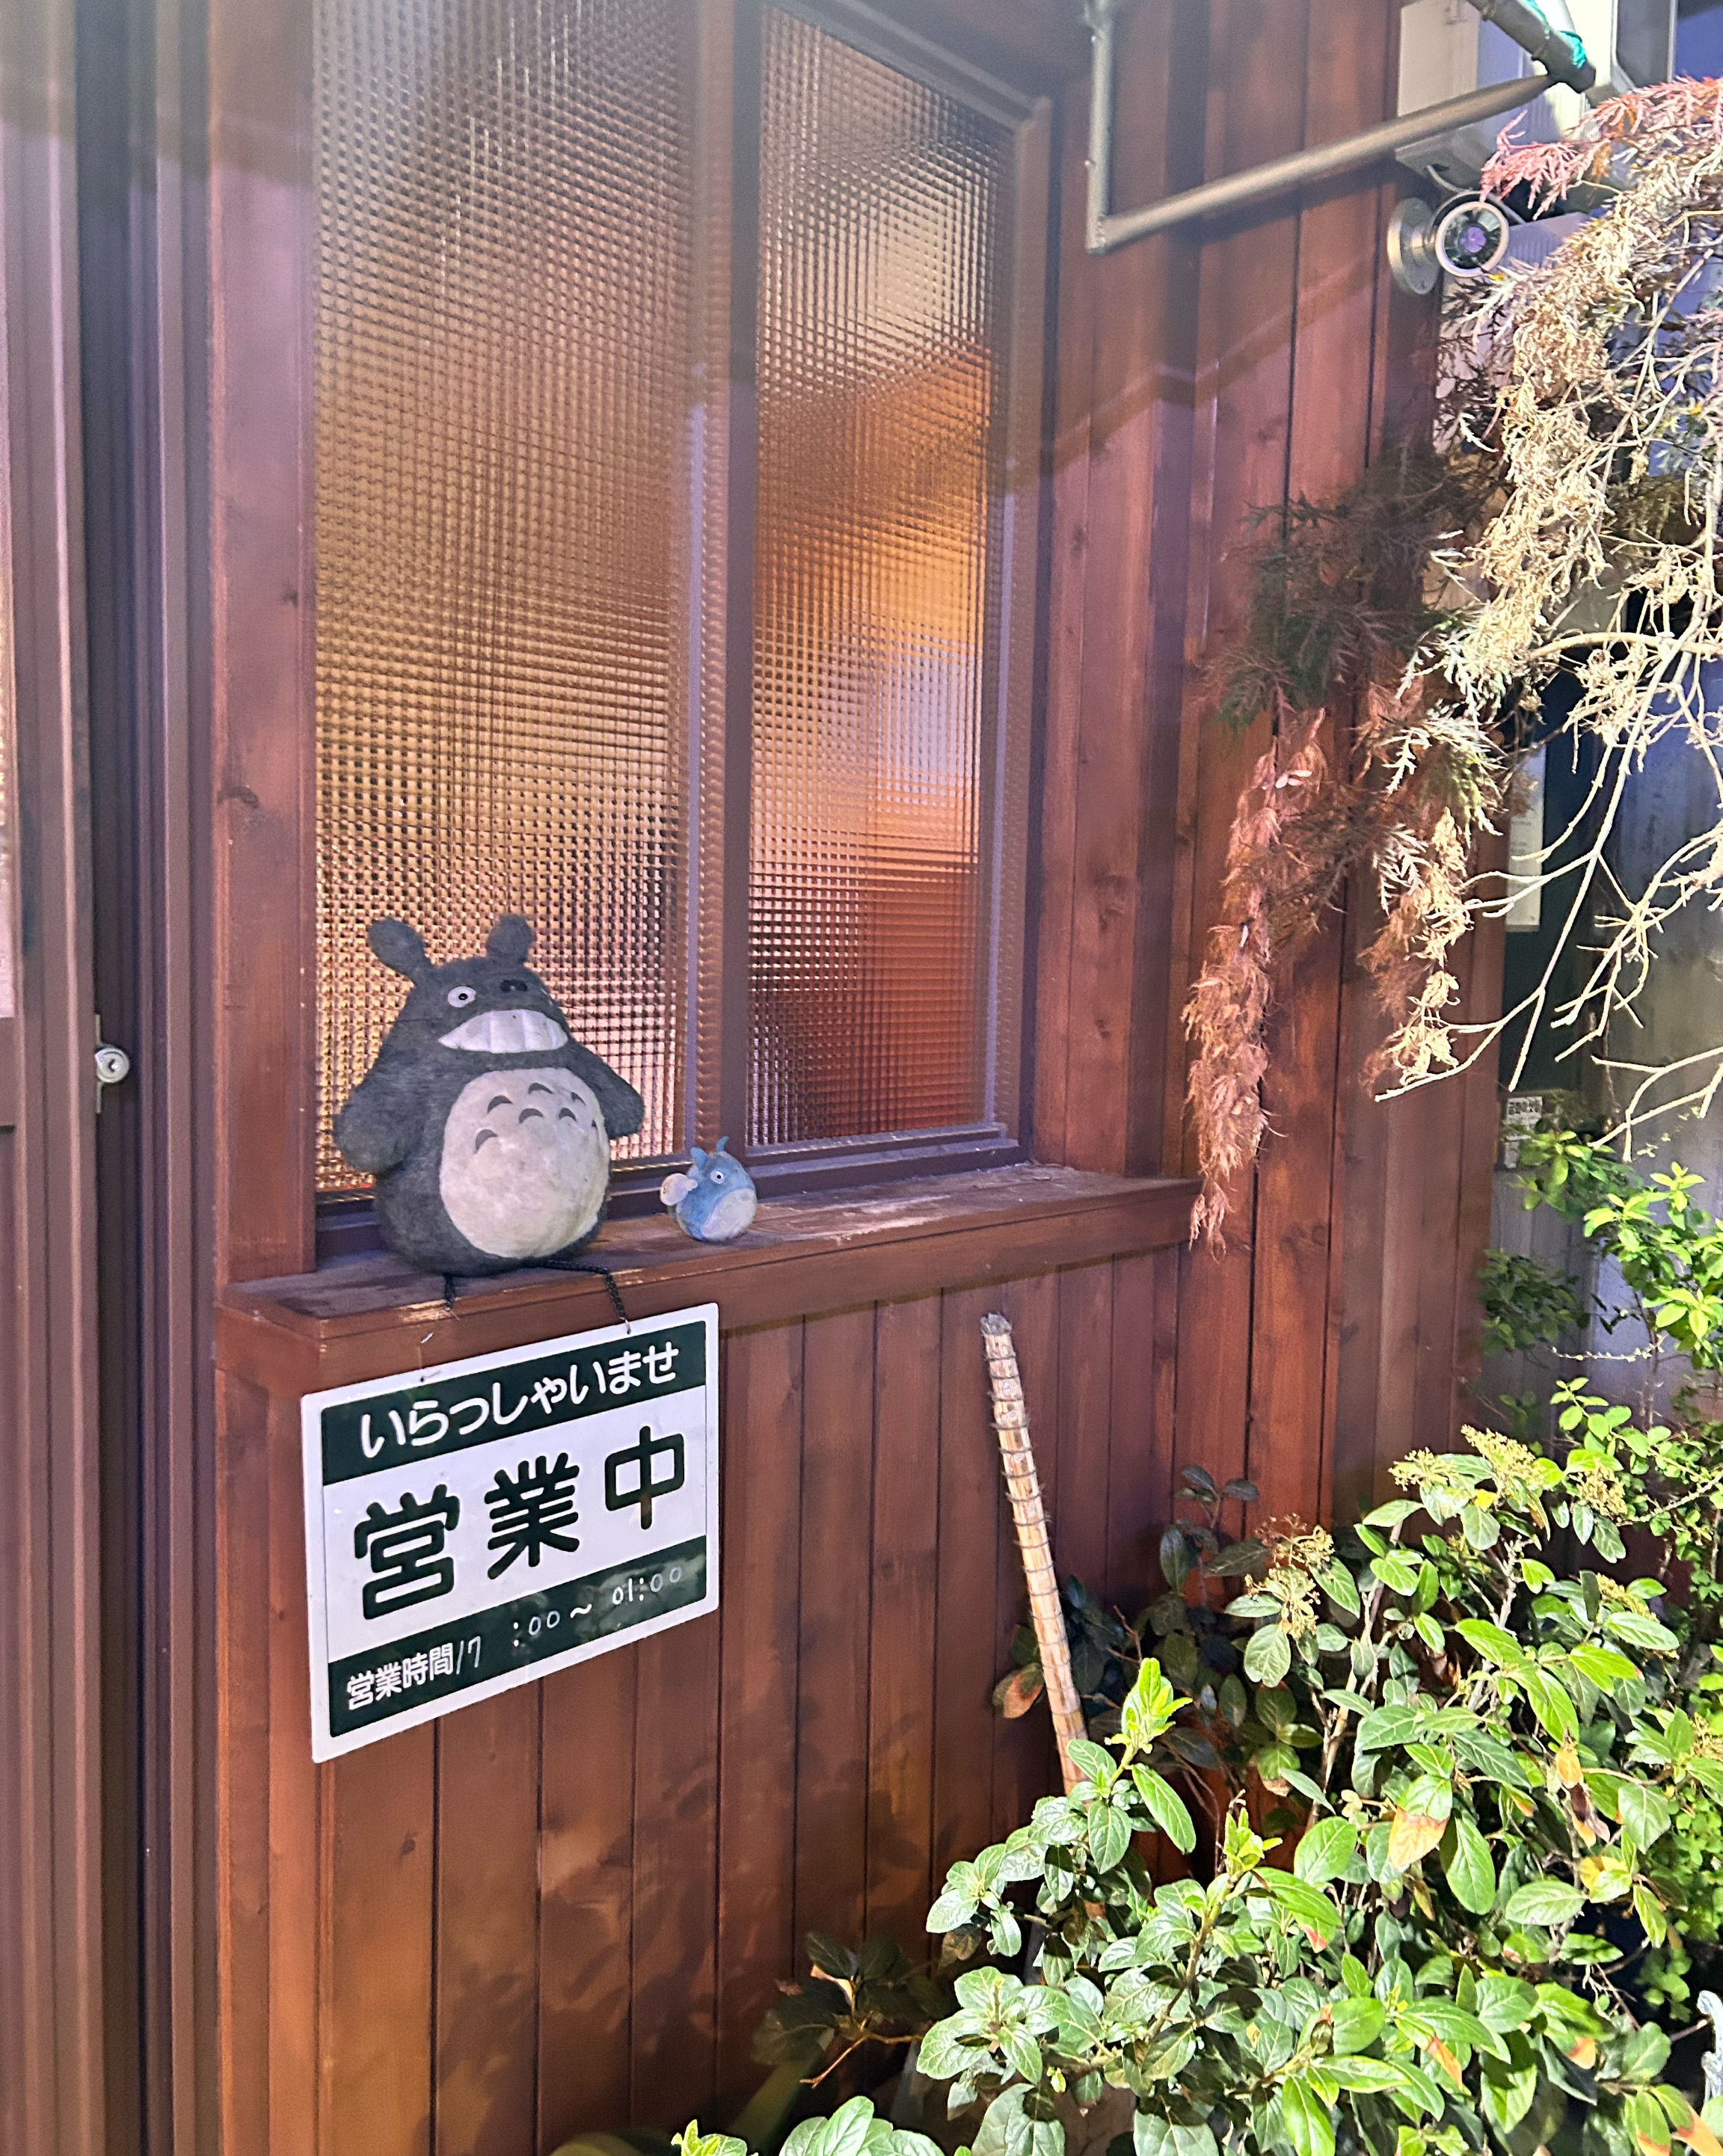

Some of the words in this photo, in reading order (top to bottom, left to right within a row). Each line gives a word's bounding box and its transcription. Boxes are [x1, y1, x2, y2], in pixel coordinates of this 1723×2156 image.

[360, 1342, 678, 1458] いらっしゃいませ
[354, 1425, 685, 1620] 営業中
[346, 1643, 454, 1710] 営業時間
